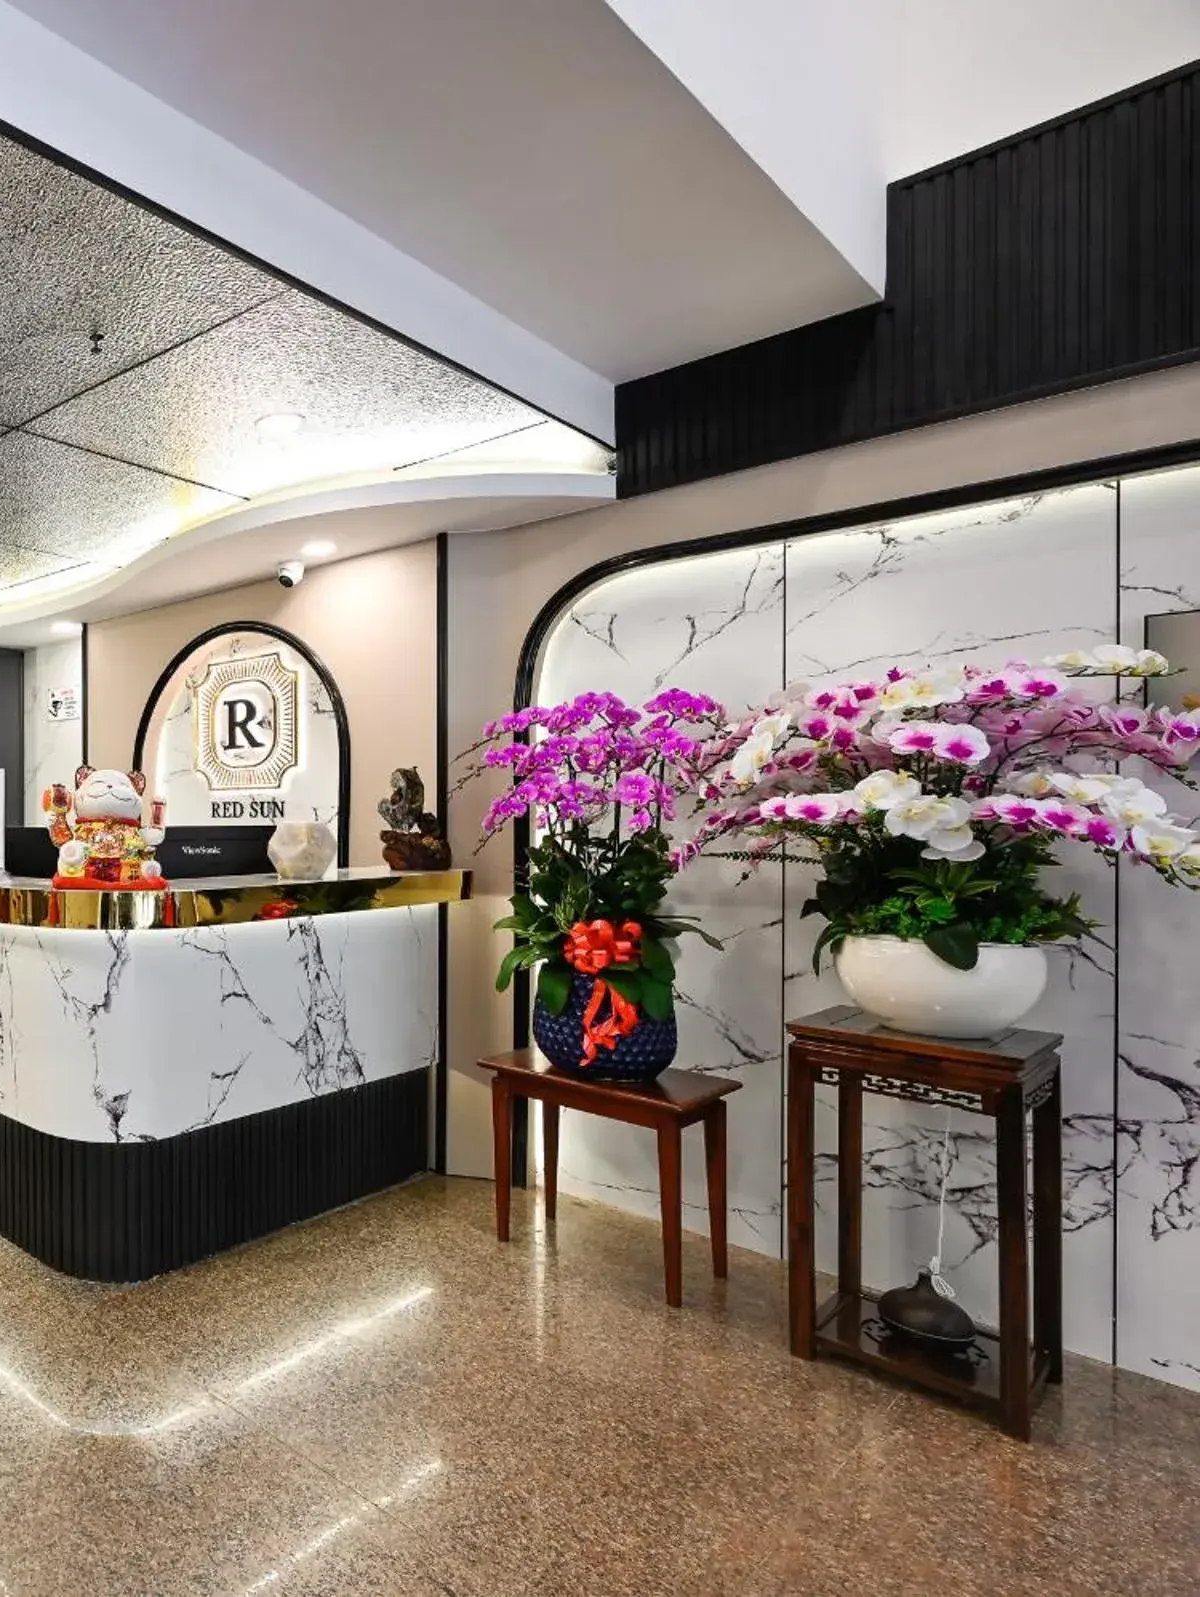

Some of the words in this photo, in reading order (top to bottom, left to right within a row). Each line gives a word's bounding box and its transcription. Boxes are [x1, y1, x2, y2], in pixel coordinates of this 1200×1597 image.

[222, 699, 266, 751] R
[211, 800, 245, 819] RED
[249, 800, 285, 819] SUN
